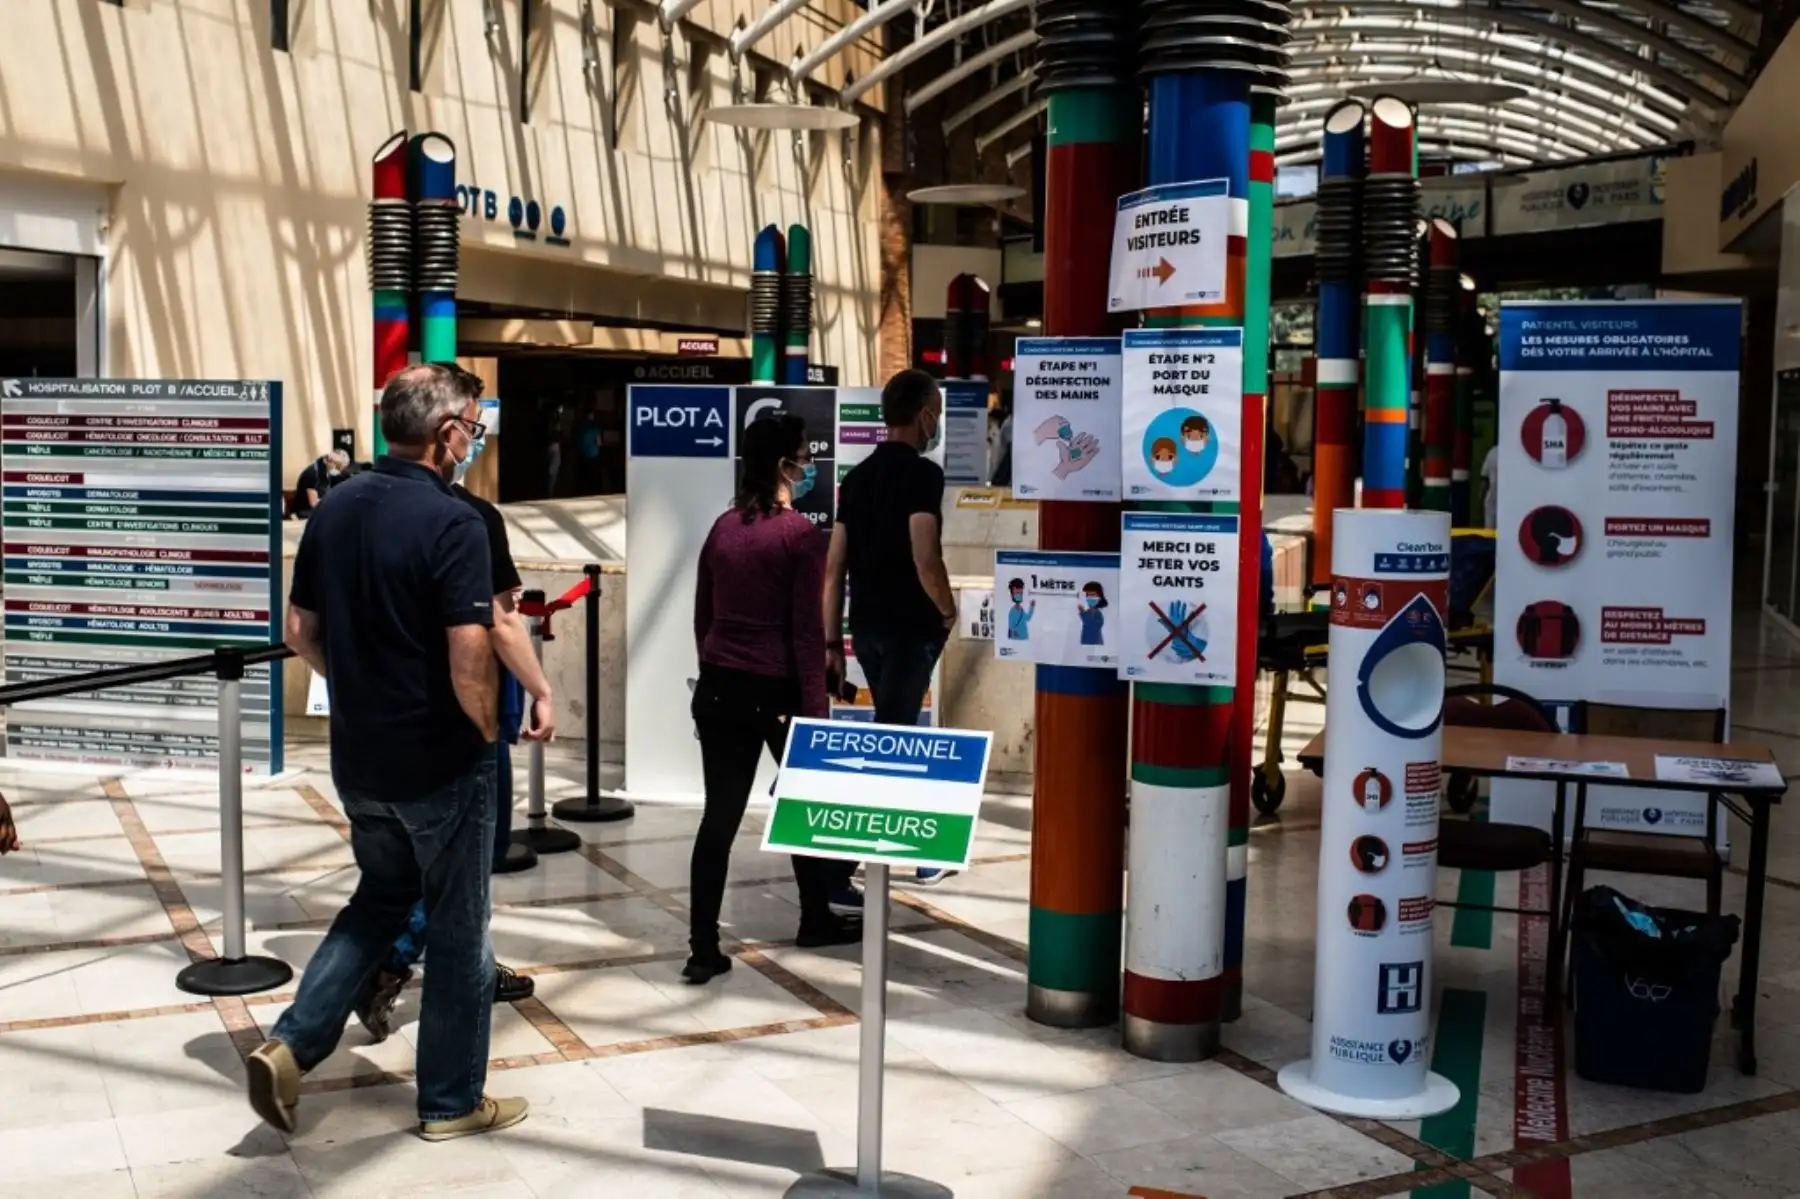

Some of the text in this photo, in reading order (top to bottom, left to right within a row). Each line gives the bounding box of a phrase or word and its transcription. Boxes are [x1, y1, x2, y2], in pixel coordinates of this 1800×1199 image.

[1134, 205, 1190, 229] ENTRÉE
[1126, 228, 1201, 252] VISITEURS
[1580, 320, 1639, 330] VISITEURS
[1521, 335, 1689, 345] LES MESURES OBLIGATOIRES
[680, 341, 716, 352] ACCUEIL
[1547, 347, 1585, 357] VOTRE
[1588, 346, 1642, 357] ARRIVÉE
[1149, 353, 1215, 364] ÉTAPE N°2
[648, 365, 714, 378] ACCUEIL
[1039, 360, 1097, 371] ÉTAPE N°1
[1026, 375, 1110, 386] DÉSINFECTION
[1152, 370, 1210, 380] PORT DU
[28, 383, 126, 395] HOSPITALISATION
[132, 384, 162, 395] PLOT
[1035, 390, 1099, 400] DES MAINS
[1153, 384, 1209, 396] MASQUE
[636, 406, 724, 428] PLOT A
[1544, 440, 1564, 449] SHA
[1143, 541, 1216, 554] MERCI DE
[1138, 558, 1220, 572] JETER VOS
[1031, 574, 1038, 588] 1
[1152, 575, 1205, 589] GANTS
[810, 730, 962, 761] PERSONNEL
[806, 807, 937, 839] VISITEURS
[1330, 1035, 1384, 1051] ASSISTANCE
[1330, 1045, 1384, 1063] PUBLIQUE
